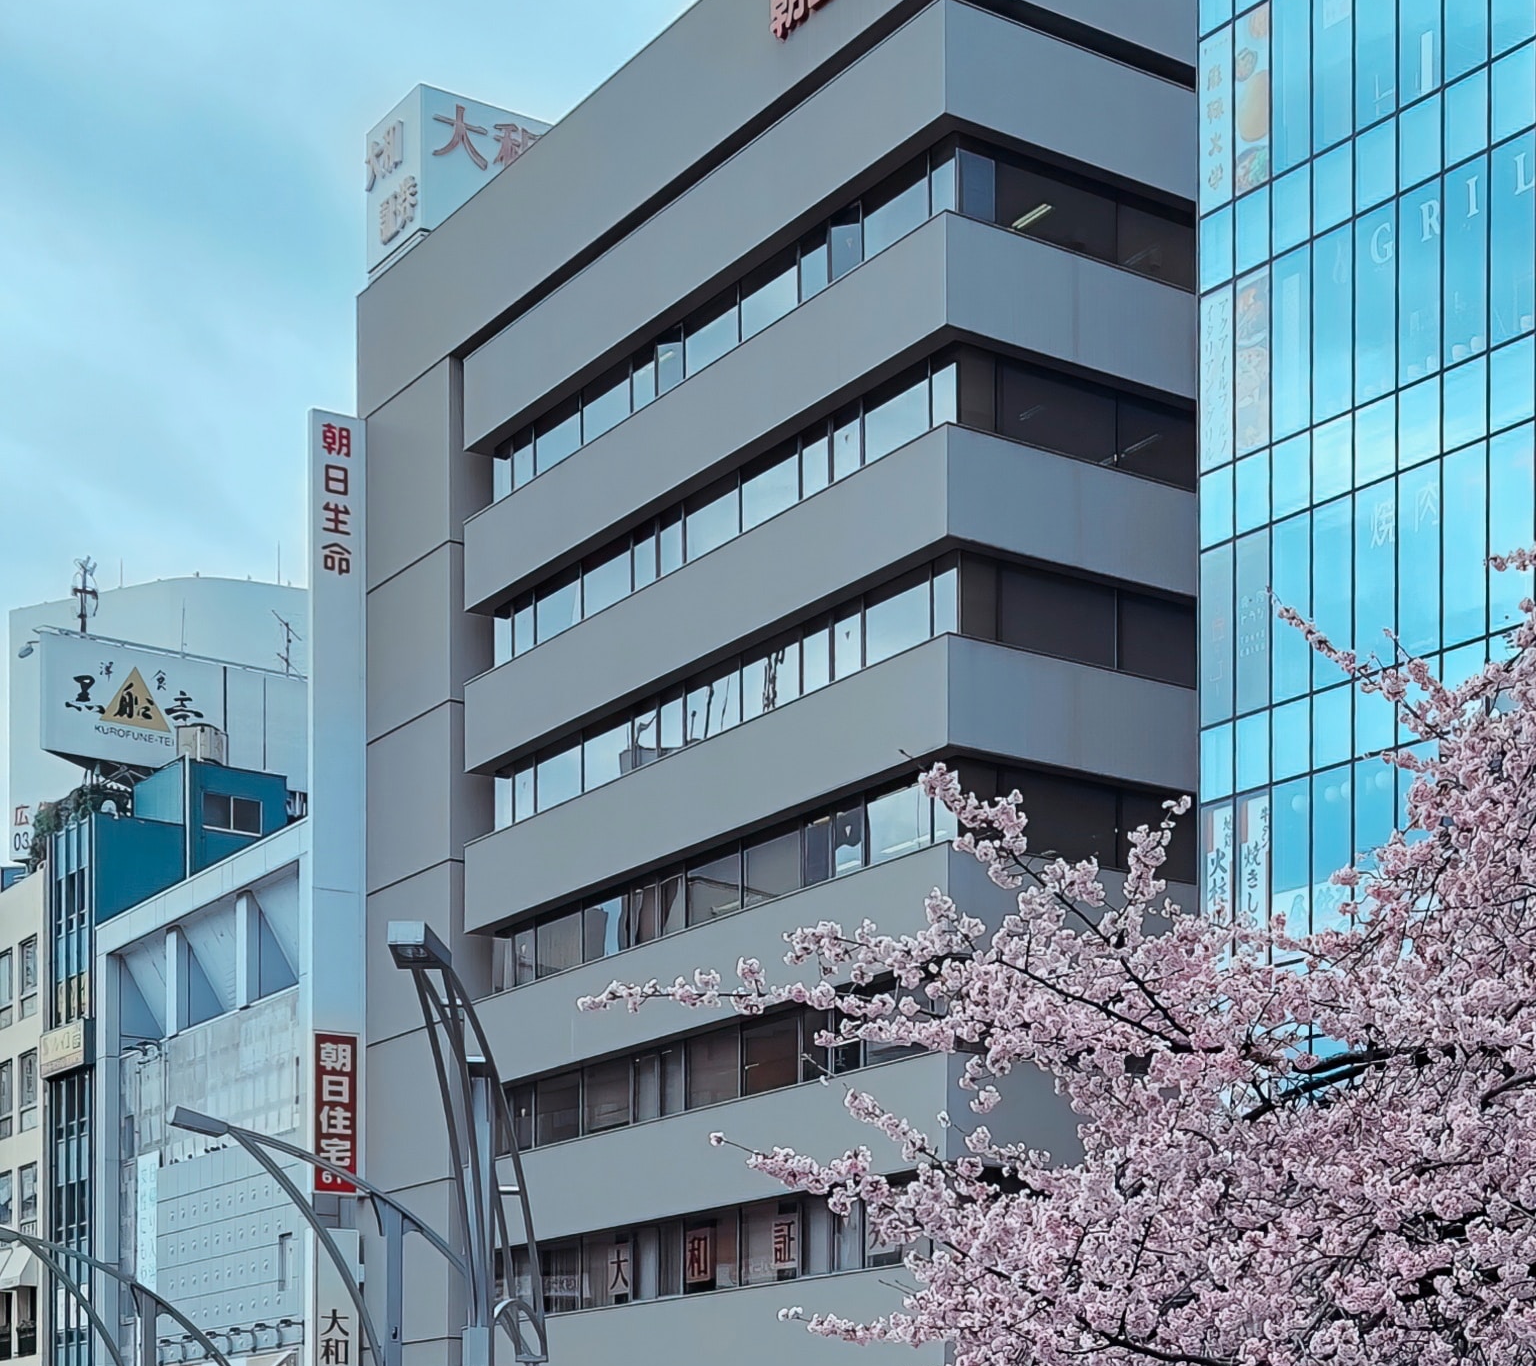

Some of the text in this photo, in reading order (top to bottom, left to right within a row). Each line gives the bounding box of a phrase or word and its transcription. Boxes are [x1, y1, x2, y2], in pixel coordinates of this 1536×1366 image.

[321, 423, 352, 577] 朝日生命
[65, 674, 204, 723] 黒船亭
[319, 1042, 352, 1167] 朝日住宅
